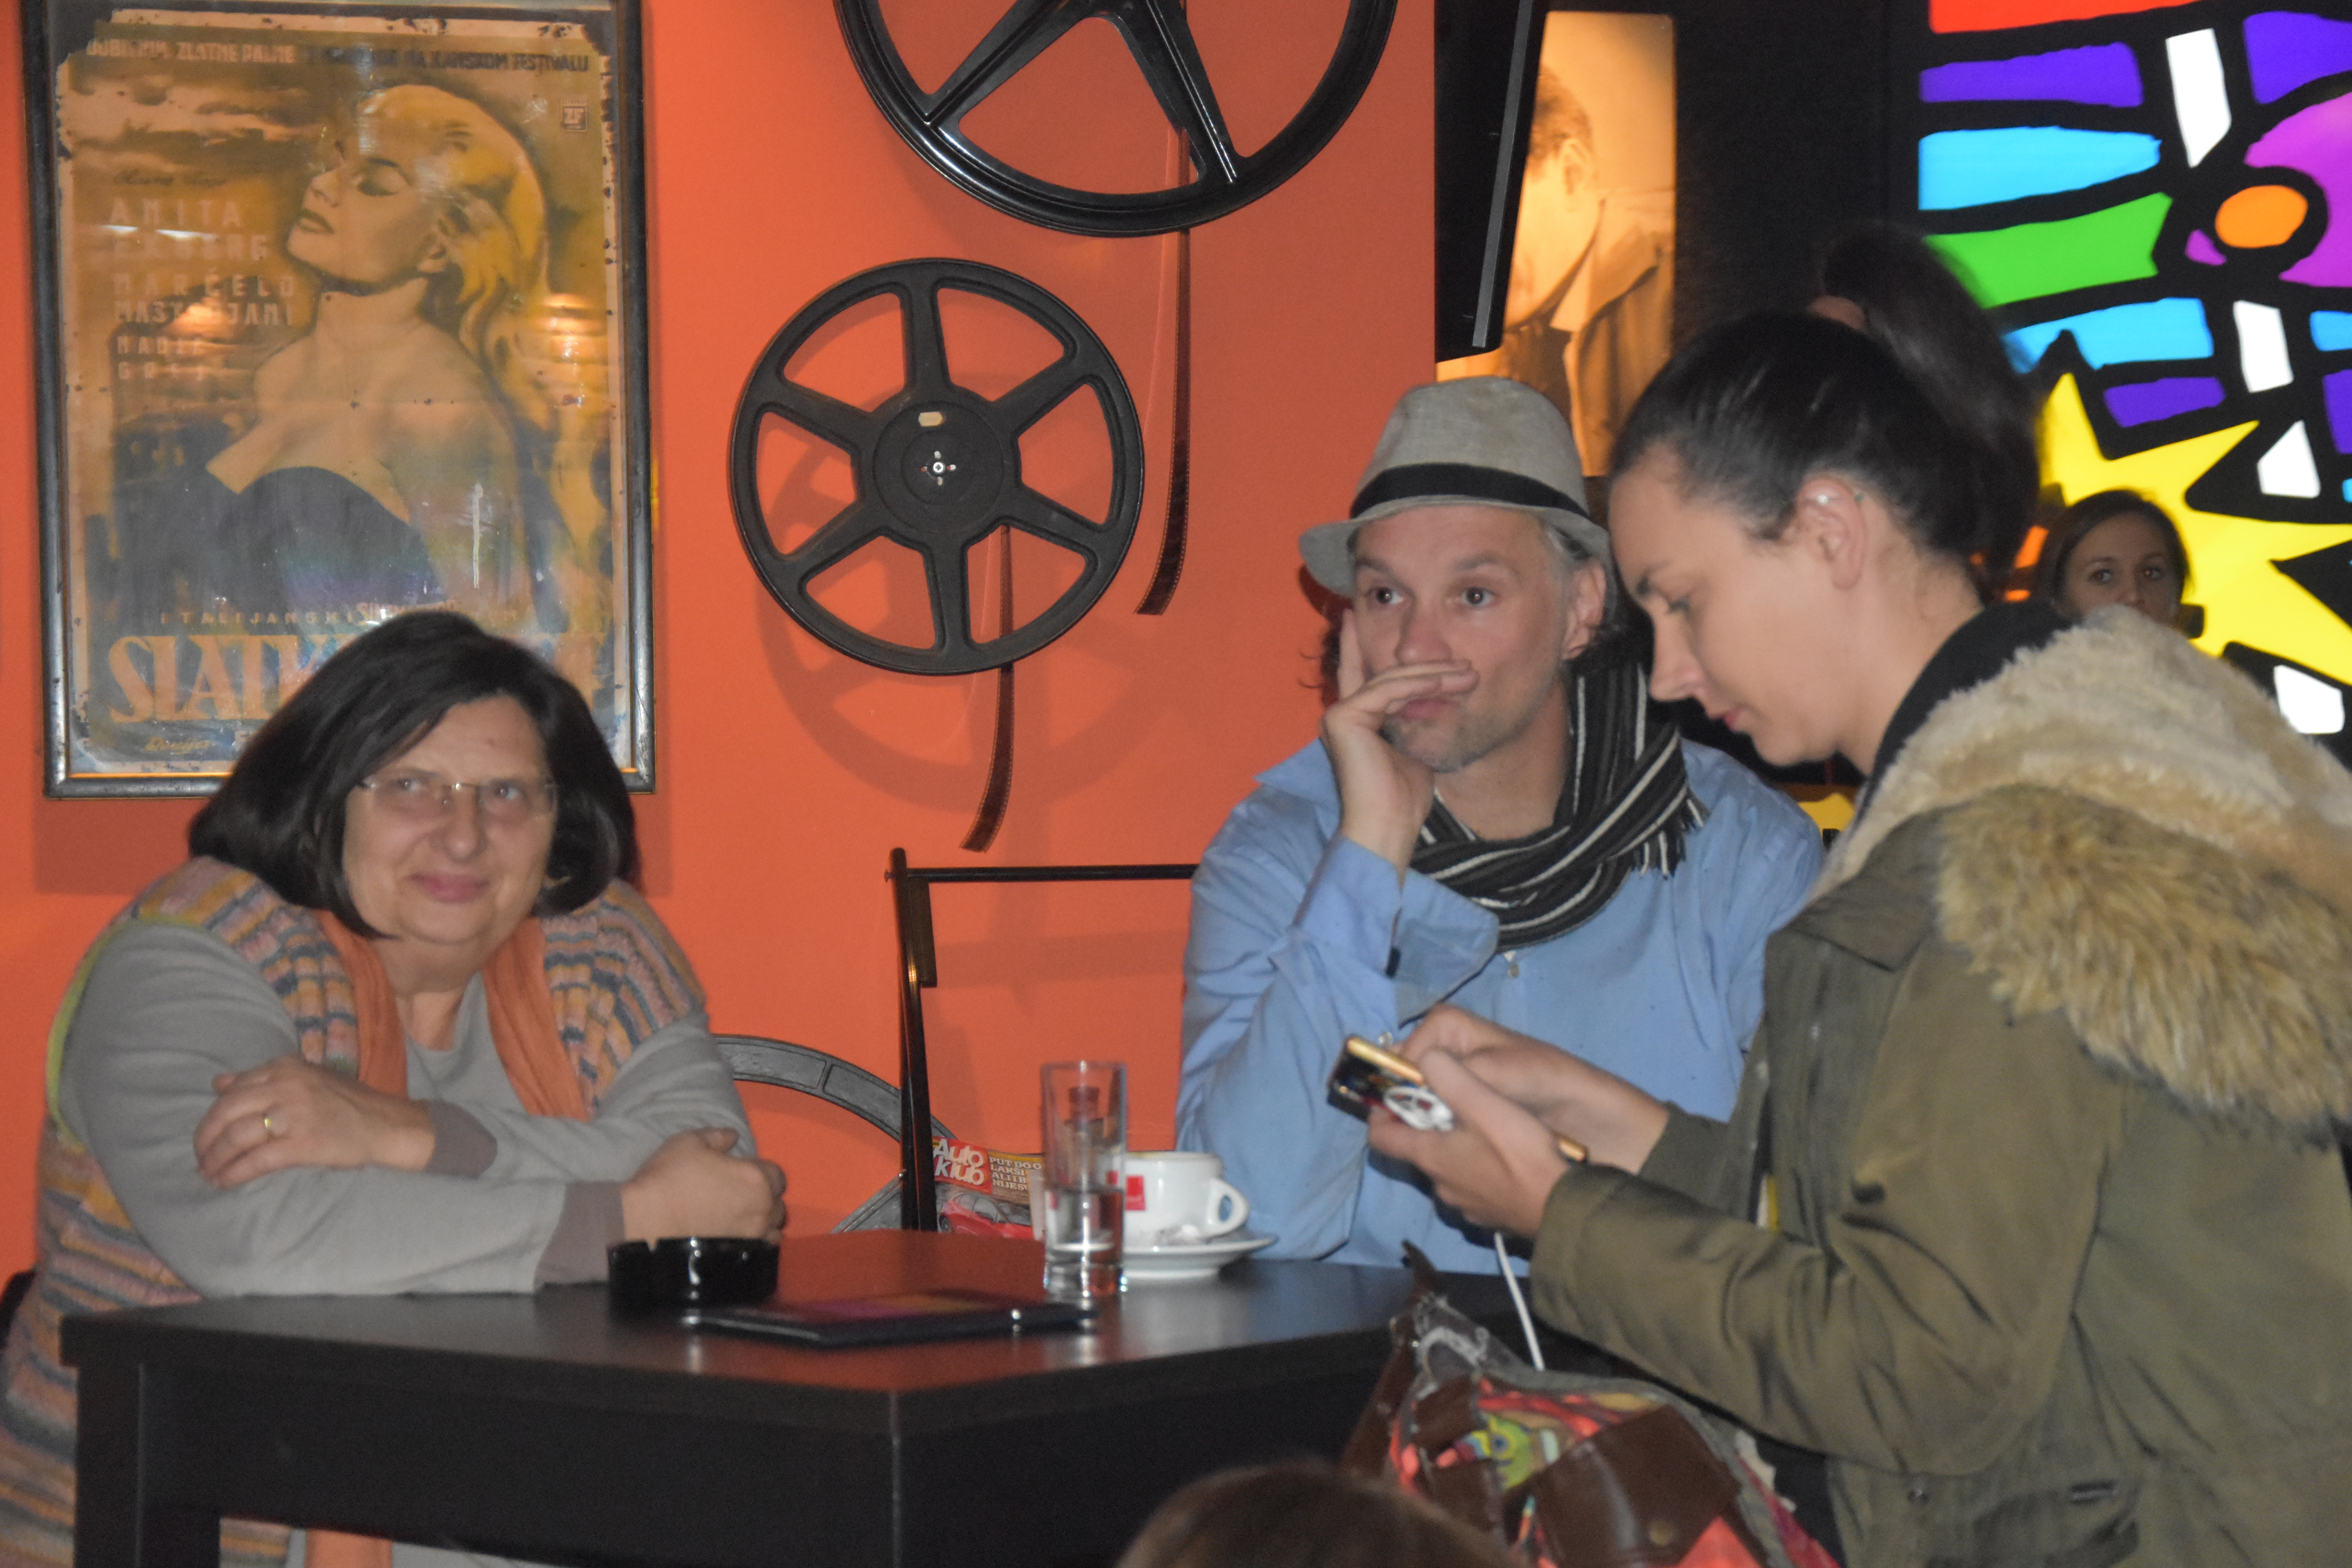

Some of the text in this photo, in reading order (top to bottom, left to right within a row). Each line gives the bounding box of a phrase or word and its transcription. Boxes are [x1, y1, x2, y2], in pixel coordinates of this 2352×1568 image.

[108, 635, 355, 722] SLATK
[933, 1138, 984, 1167] Auto
[989, 1156, 1012, 1167] PUT
[935, 1155, 985, 1185] klub
[992, 1172, 1011, 1182] ALI
[993, 1179, 1016, 1190] NIJE
